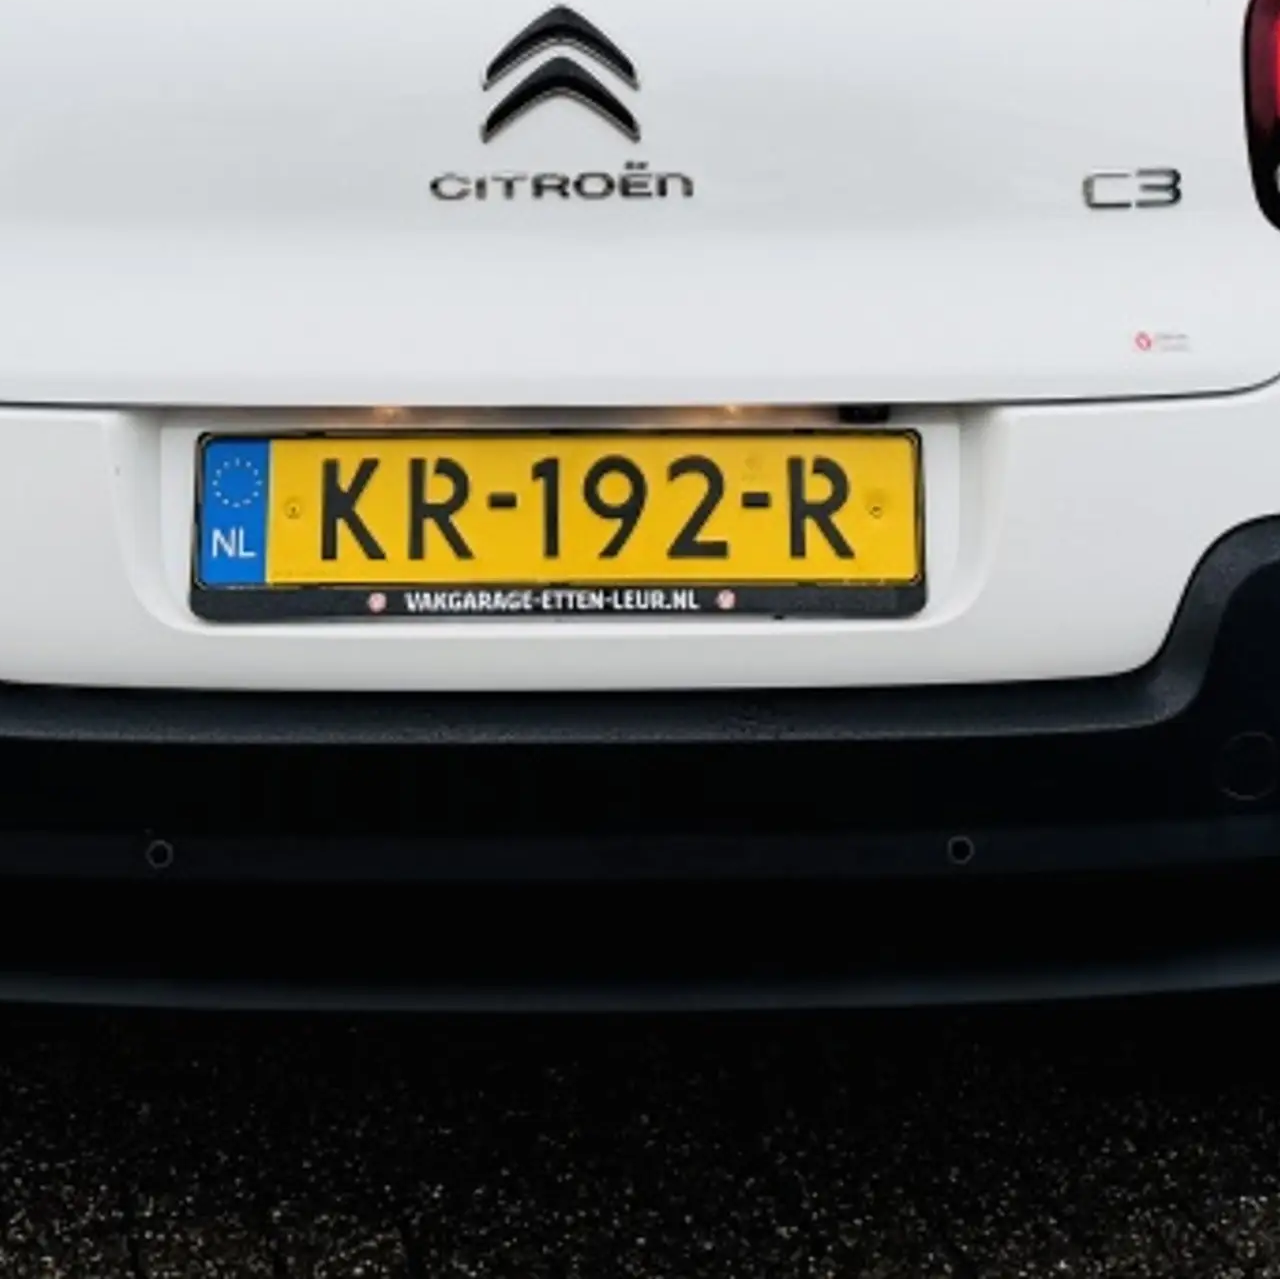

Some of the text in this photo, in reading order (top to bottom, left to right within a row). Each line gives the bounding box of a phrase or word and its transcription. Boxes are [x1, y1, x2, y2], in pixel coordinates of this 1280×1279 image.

[429, 160, 694, 200] CITROËN
[1082, 168, 1182, 209] C3
[321, 454, 856, 560] KR-192-R
[212, 526, 257, 558] NL
[404, 589, 700, 611] VAKGARAGE-ETTEN-LEUR.NL
